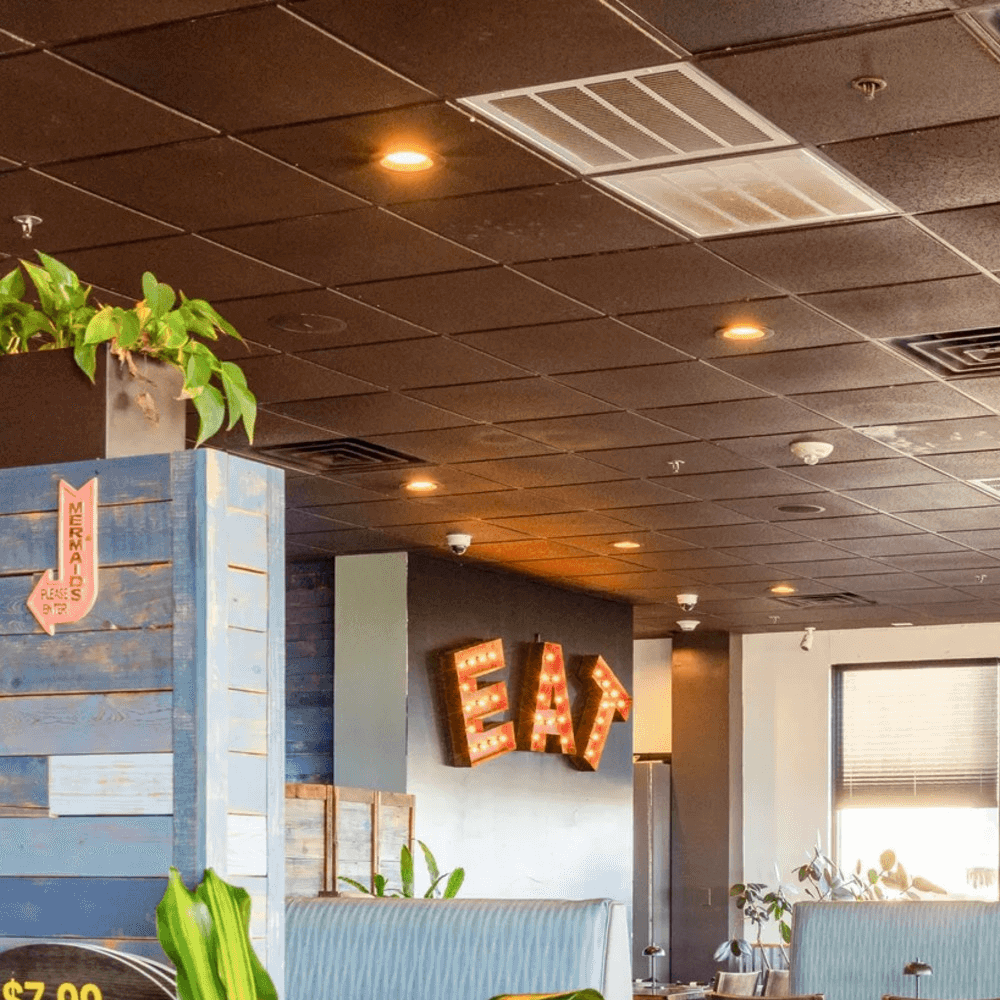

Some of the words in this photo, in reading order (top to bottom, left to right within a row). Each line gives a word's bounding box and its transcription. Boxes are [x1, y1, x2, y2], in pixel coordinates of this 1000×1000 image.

[40, 587, 68, 600] PLEASE
[68, 501, 83, 601] MERMAIDS
[443, 637, 632, 771] EAT
